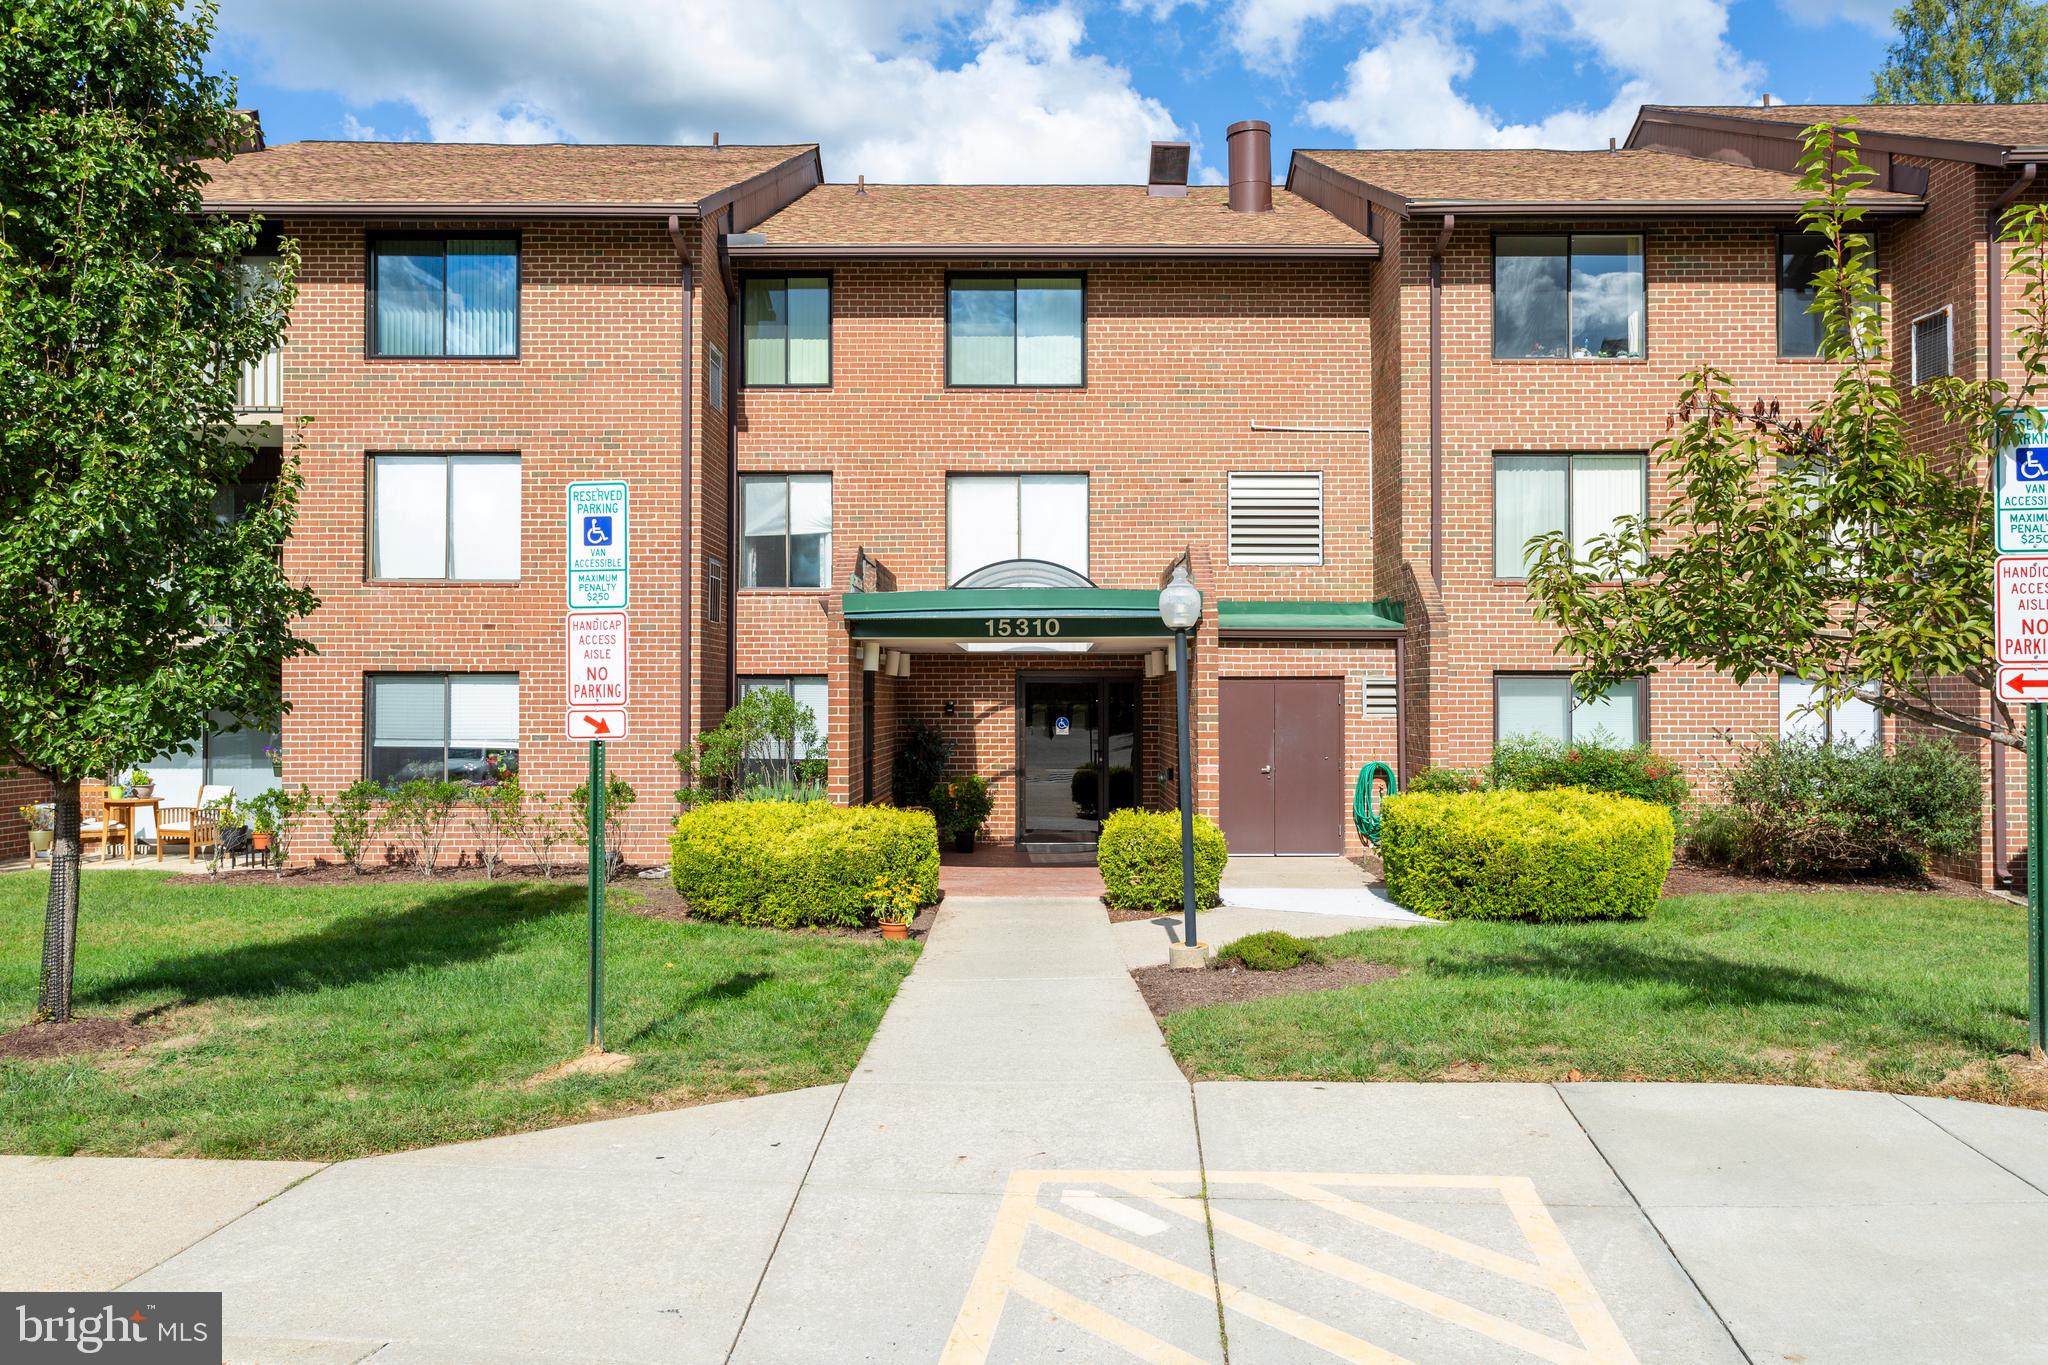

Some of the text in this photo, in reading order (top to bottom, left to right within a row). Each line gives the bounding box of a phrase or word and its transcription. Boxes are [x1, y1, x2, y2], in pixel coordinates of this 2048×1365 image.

[2025, 484, 2045, 494] VAN
[573, 490, 622, 502] RESERVED
[2004, 496, 2047, 506] ACCESSI
[577, 503, 619, 514] PARKING
[590, 548, 606, 557] VAN
[574, 558, 622, 568] ACCESSIBLE
[2003, 566, 2048, 578] HANDIC
[578, 574, 618, 582] MAXIMUM
[578, 583, 617, 592] PENALTY
[587, 592, 610, 602] $250
[2018, 598, 2048, 610] AISL
[572, 620, 622, 631] HANDICAP
[985, 618, 1060, 636] 15310
[2021, 619, 2048, 635] NO
[578, 634, 617, 645] ACCESS
[2005, 638, 2047, 655] PARKI
[583, 649, 611, 660] AISLE
[586, 666, 608, 681] NO
[573, 683, 622, 699] PARKING
